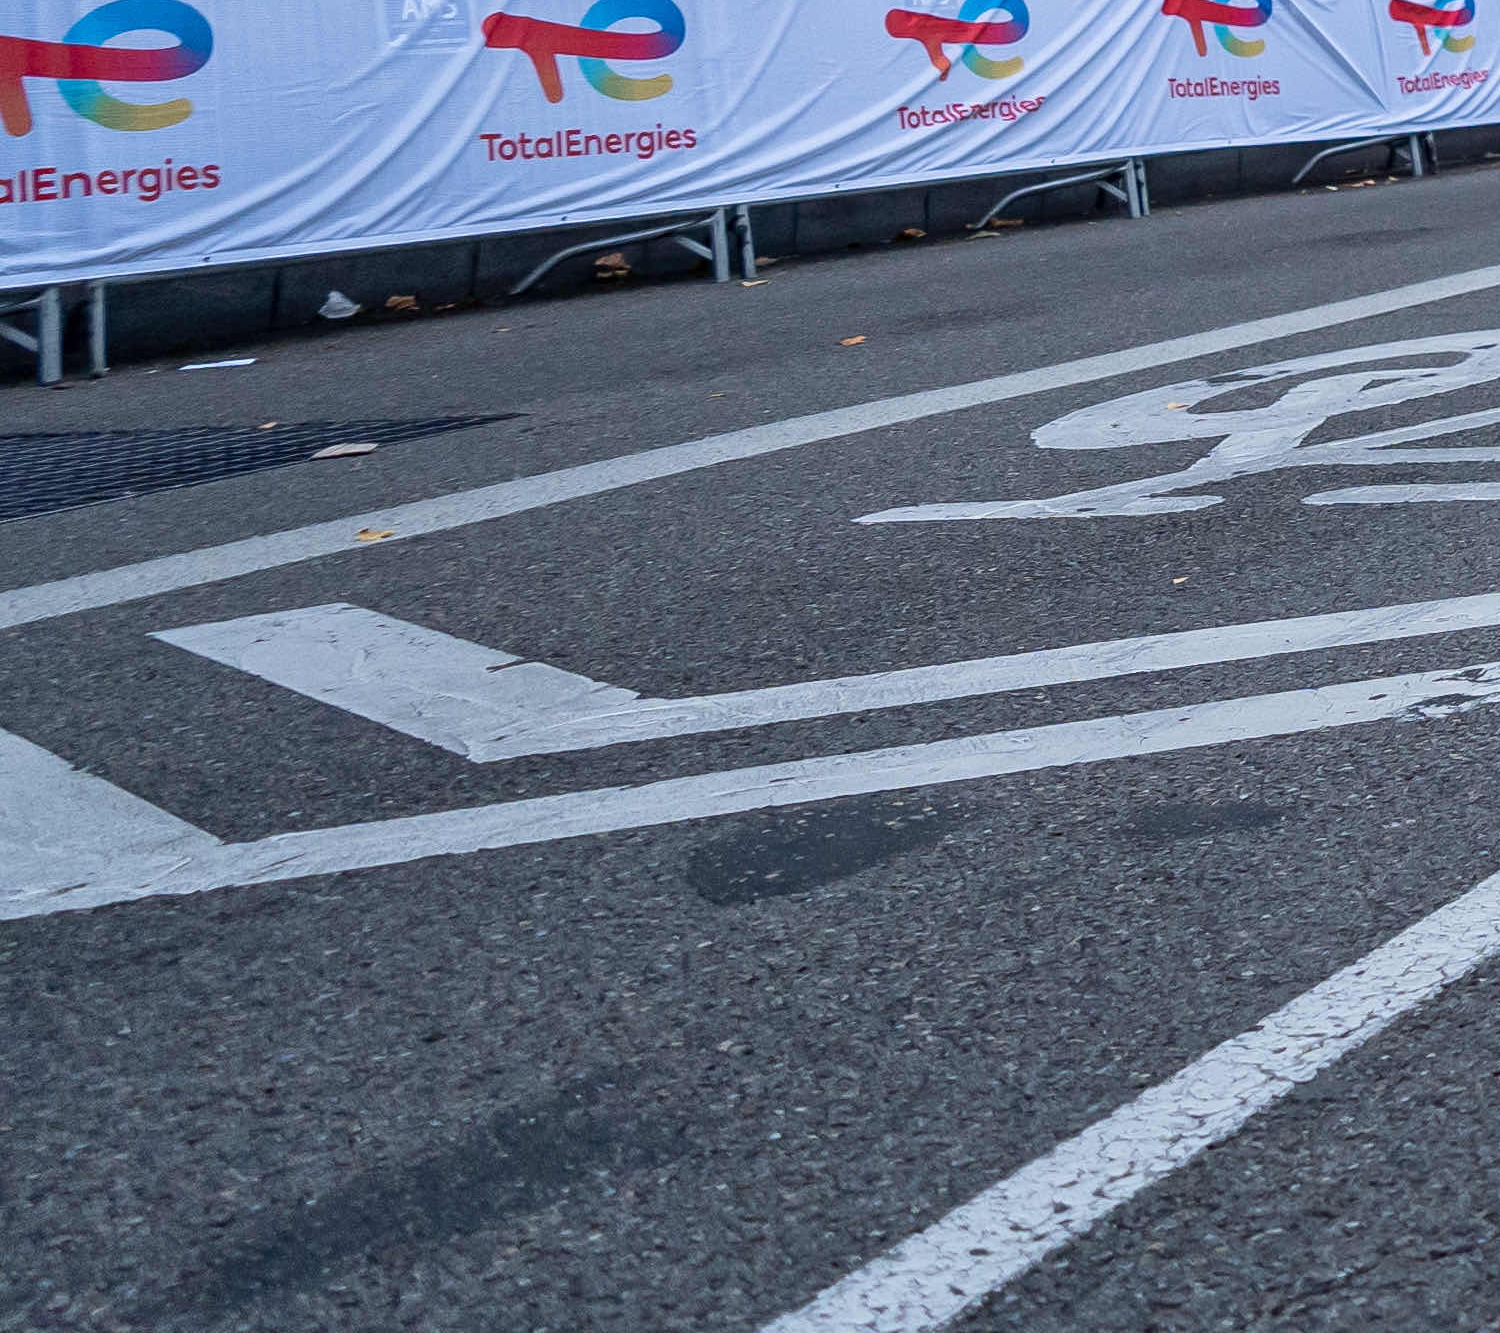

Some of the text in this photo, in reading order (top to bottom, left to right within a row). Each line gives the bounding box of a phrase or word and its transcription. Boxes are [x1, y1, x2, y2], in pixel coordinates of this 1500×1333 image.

[1168, 75, 1281, 101] TotalEnergies
[1397, 68, 1489, 94] TotalEnegies
[479, 124, 697, 162] TotalEnergies
